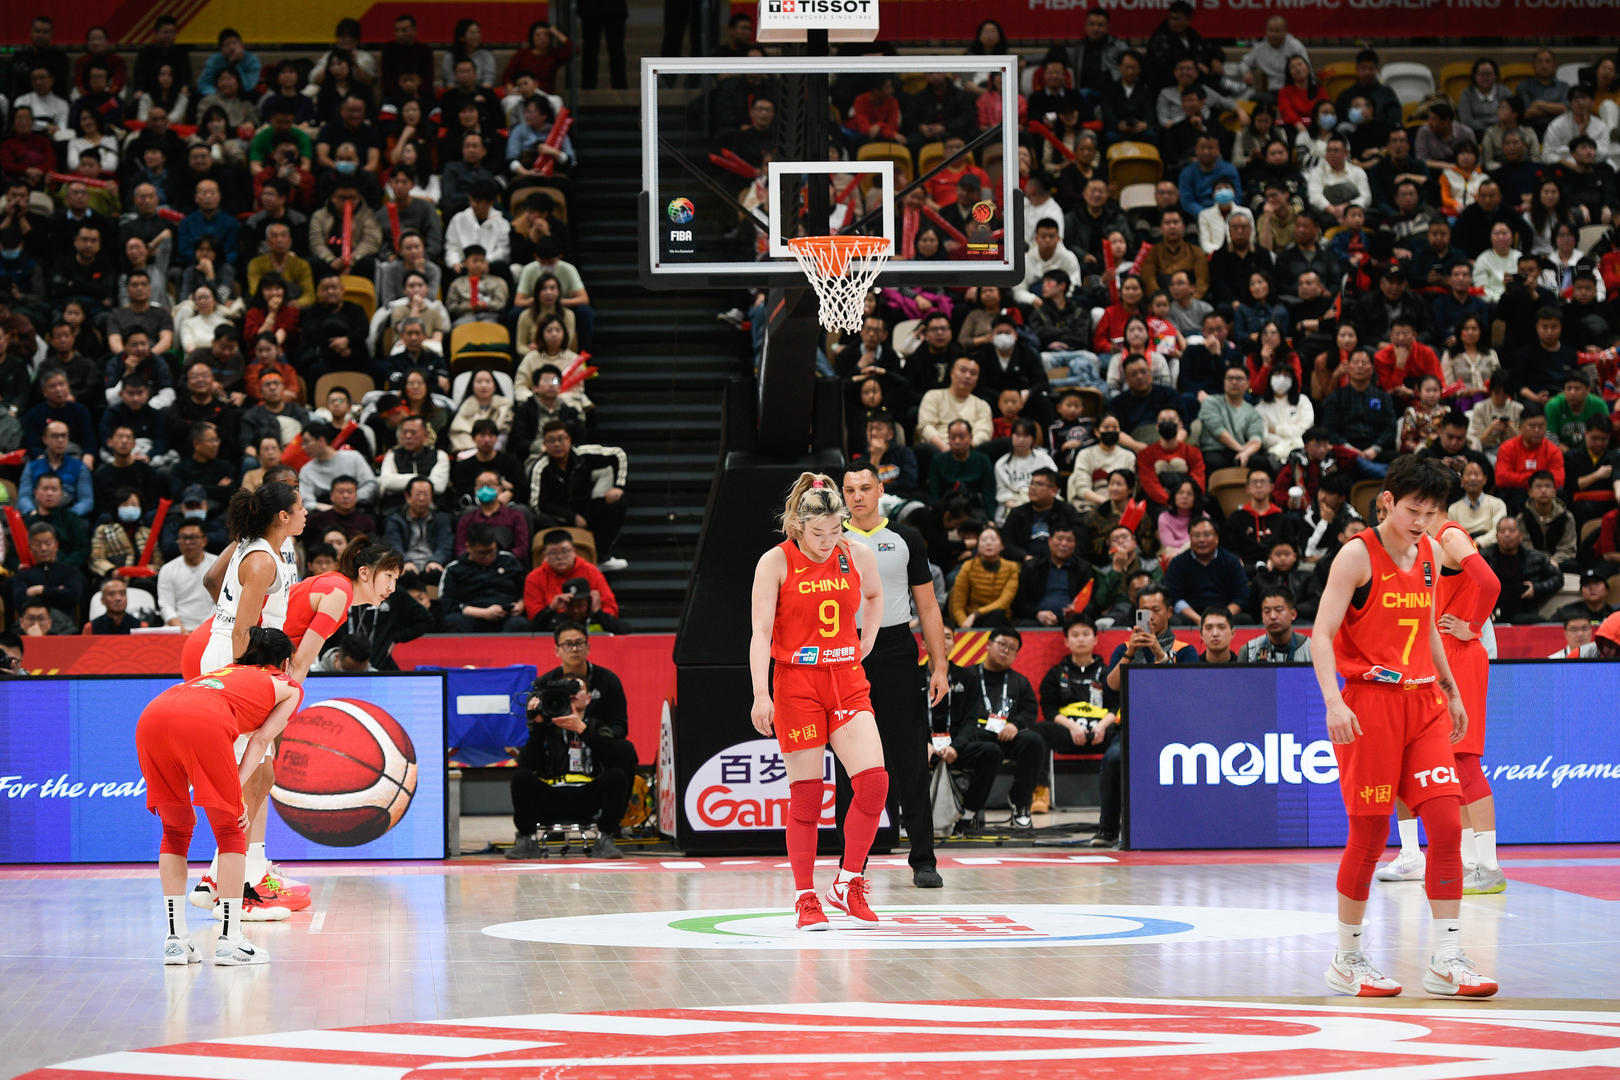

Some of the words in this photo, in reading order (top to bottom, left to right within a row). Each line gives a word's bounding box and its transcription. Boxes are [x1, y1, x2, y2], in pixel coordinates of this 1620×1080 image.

[798, 1, 871, 12] TISSOT
[1097, 0, 1220, 10] WOME'S
[671, 230, 692, 241] FIBA
[799, 578, 850, 594] CHINA
[1382, 592, 1432, 608] CHINA
[819, 600, 840, 637] 9
[1398, 619, 1419, 665] 7
[788, 724, 817, 743] 中国
[720, 753, 831, 785] 百岁
[1159, 733, 1340, 786] molte
[1413, 766, 1460, 788] TCL
[1493, 755, 1553, 781] real
[1551, 762, 1620, 789] game
[0, 775, 38, 799] For
[39, 774, 87, 798] the
[88, 776, 147, 798] real
[1359, 784, 1392, 804] 中国
